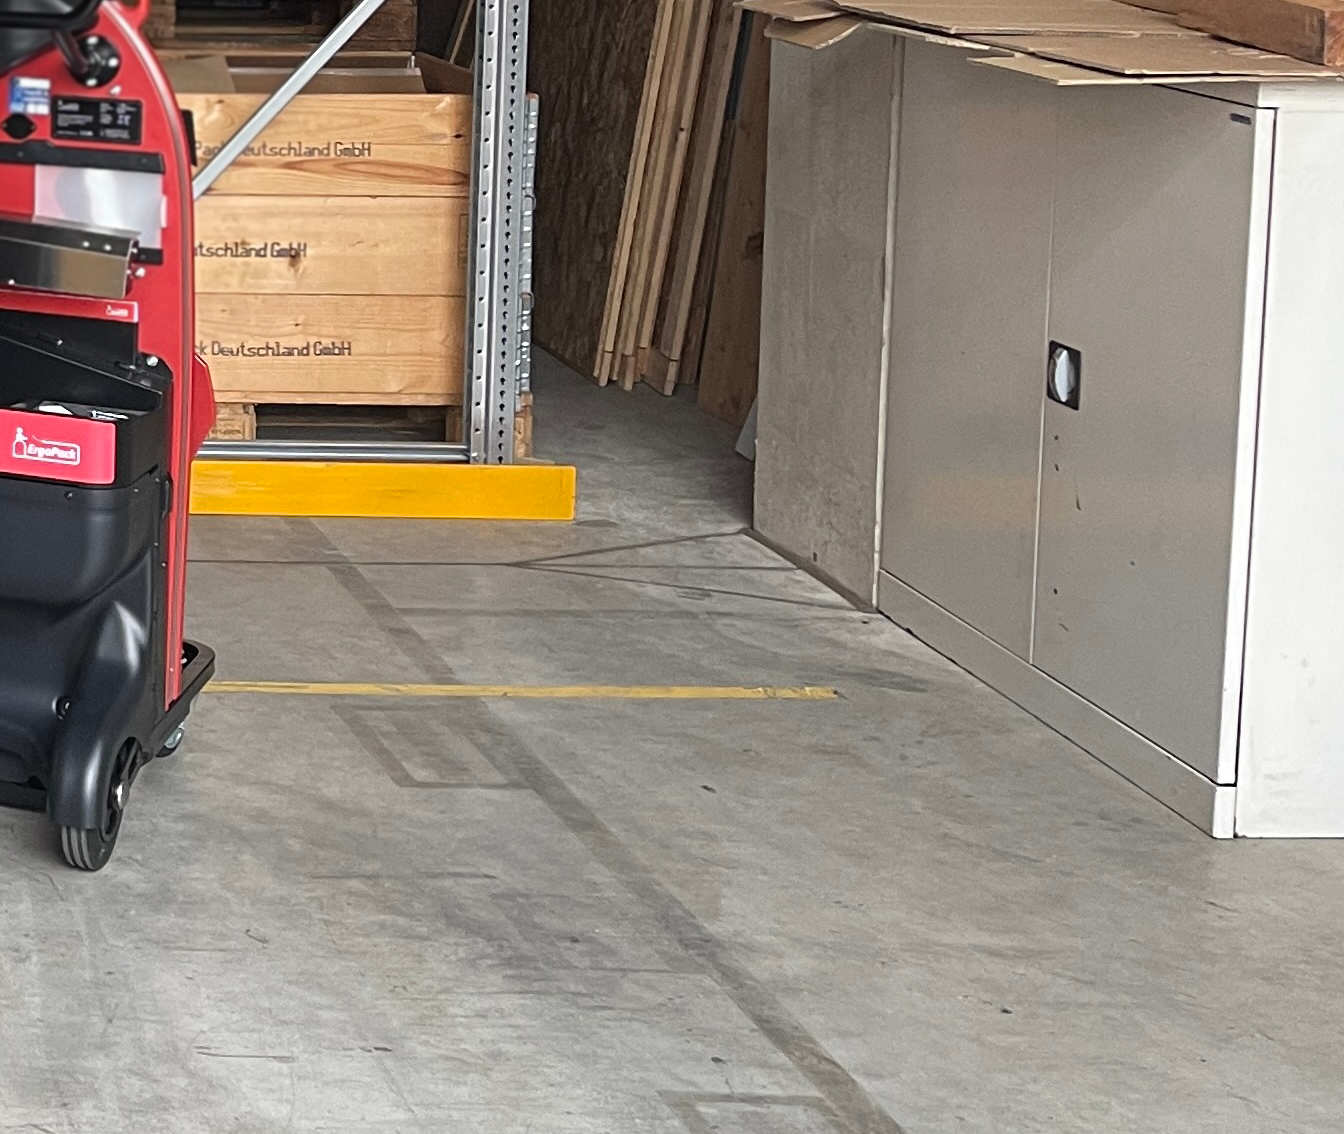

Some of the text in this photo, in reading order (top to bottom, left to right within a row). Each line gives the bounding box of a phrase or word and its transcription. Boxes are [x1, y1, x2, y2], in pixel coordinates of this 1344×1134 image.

[195, 141, 371, 157] Pac eutschland GmbH
[270, 242, 307, 258] GmbH
[211, 341, 310, 356] Deutschland
[313, 341, 352, 356] GmbH
[27, 443, 77, 460] ErgoPack
